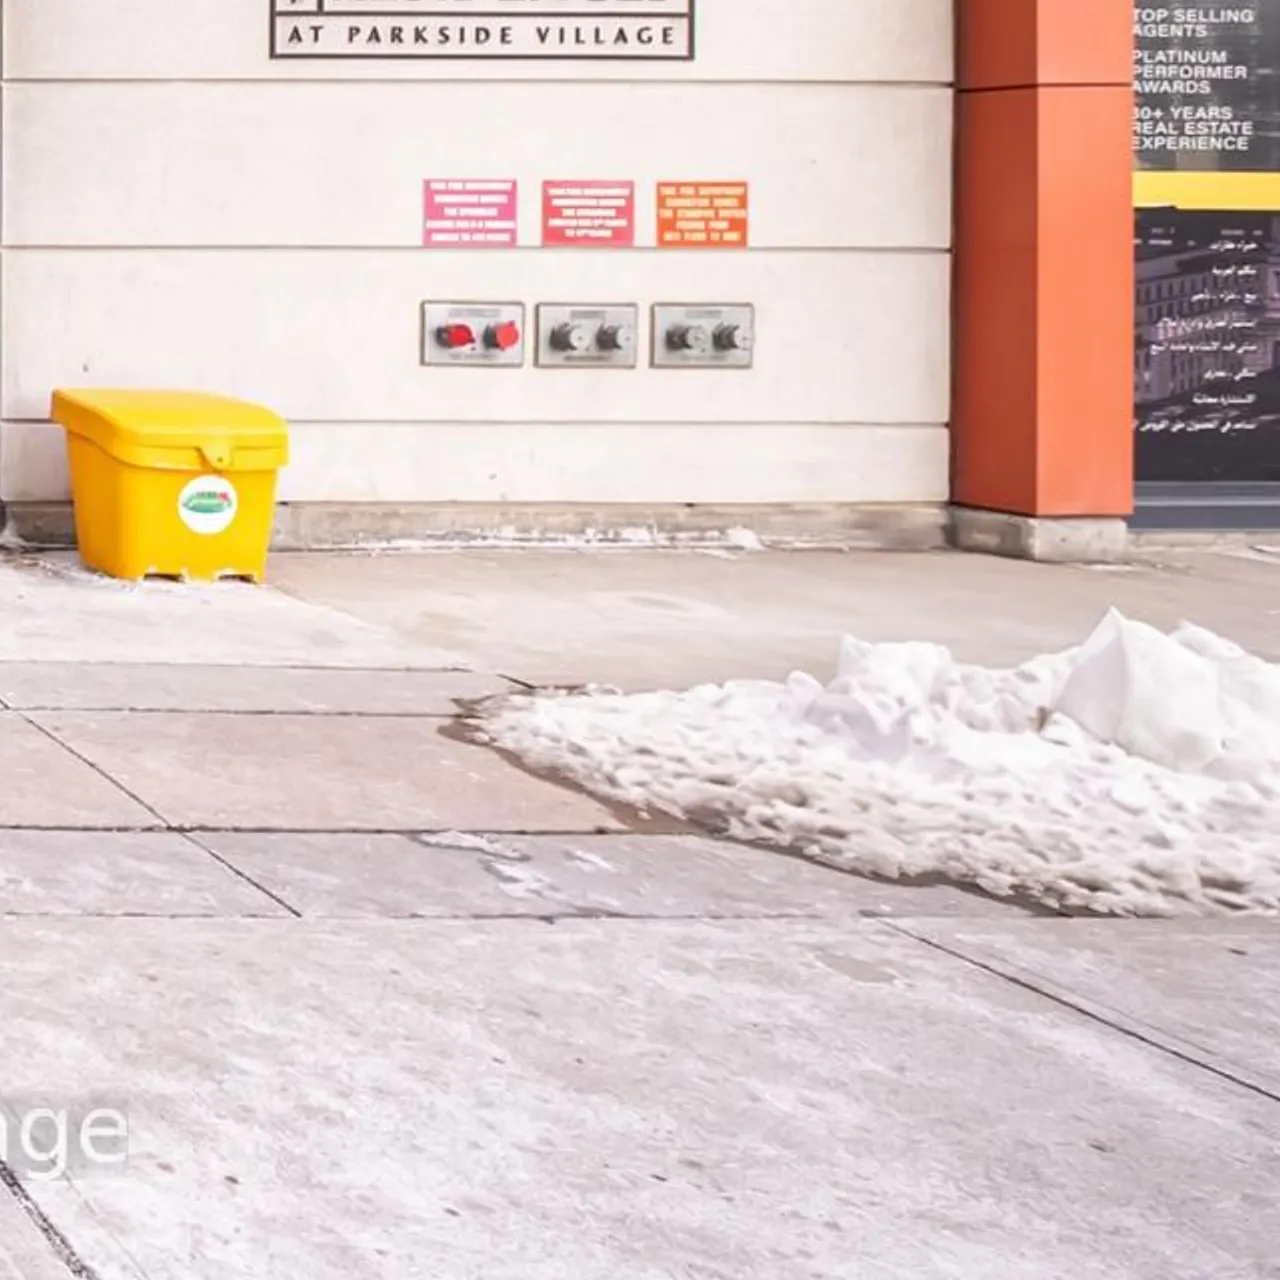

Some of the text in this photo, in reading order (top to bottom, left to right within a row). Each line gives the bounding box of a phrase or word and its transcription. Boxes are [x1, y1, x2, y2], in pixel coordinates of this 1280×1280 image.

[1133, 8, 1254, 23] TOP SELLING
[288, 26, 675, 45] AT PARKSIDE VILLAGE
[1133, 23, 1208, 37] AGENTS
[1133, 50, 1227, 63] PLATINUM
[1133, 65, 1248, 79] PERFORMER
[1133, 80, 1211, 94] AWARDS
[1170, 106, 1233, 120] YEARS
[1133, 121, 1253, 135] REAL ESTATE
[1133, 136, 1249, 150] EXPERIENCE
